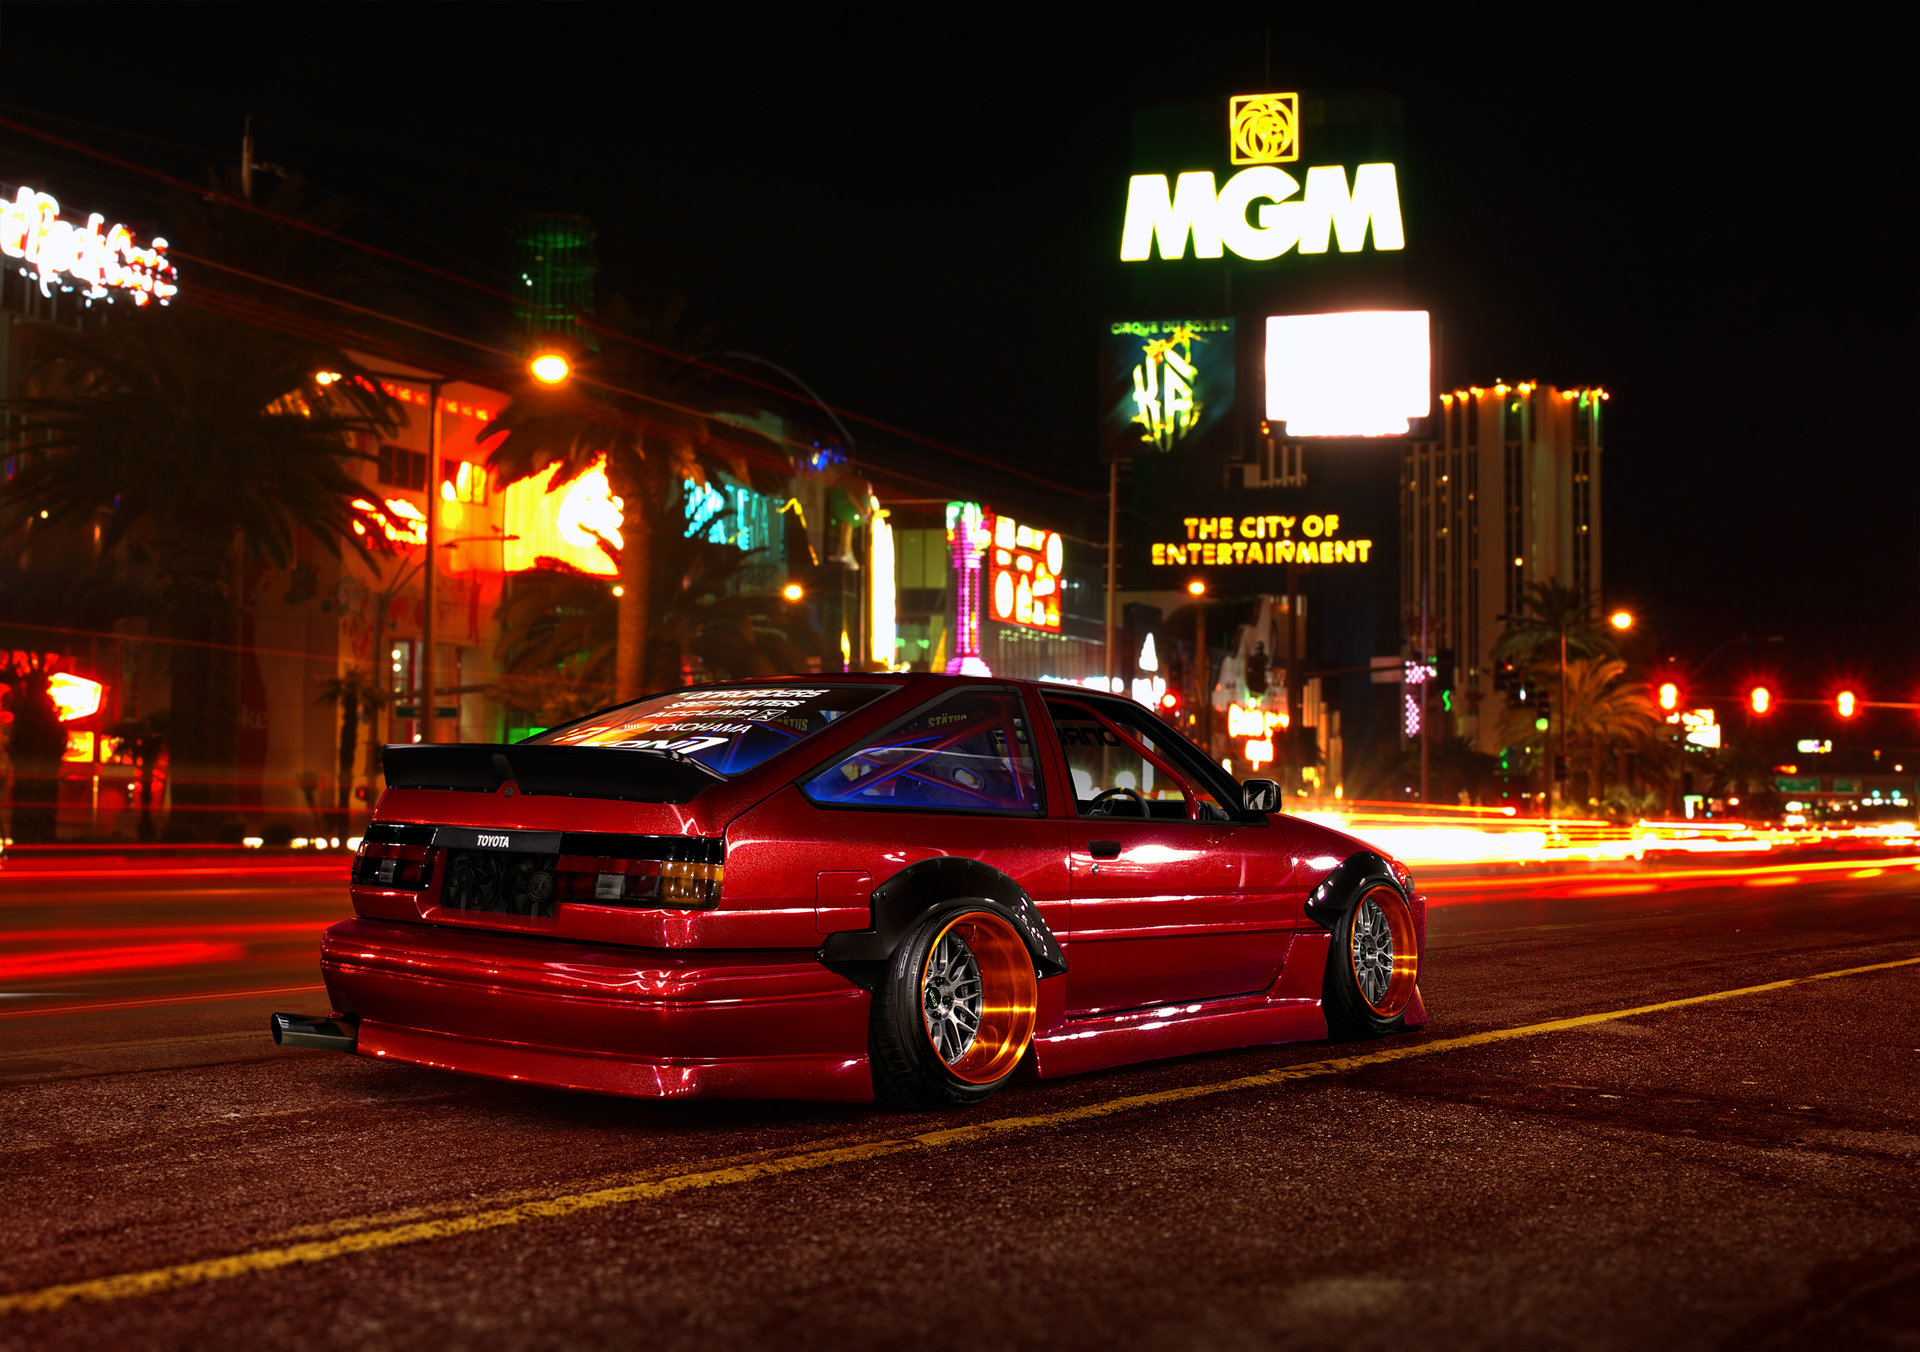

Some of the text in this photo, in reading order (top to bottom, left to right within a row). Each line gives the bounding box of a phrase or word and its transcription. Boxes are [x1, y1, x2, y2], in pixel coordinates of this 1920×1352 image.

[1120, 162, 1406, 262] MGM
[1110, 321, 1159, 337] CIRQUE
[1183, 514, 1339, 540] THE CITY OF
[1151, 539, 1373, 566] ENTERTAINMENT
[646, 722, 752, 735] YOKOHAMA
[477, 835, 509, 848] TOYOTA
